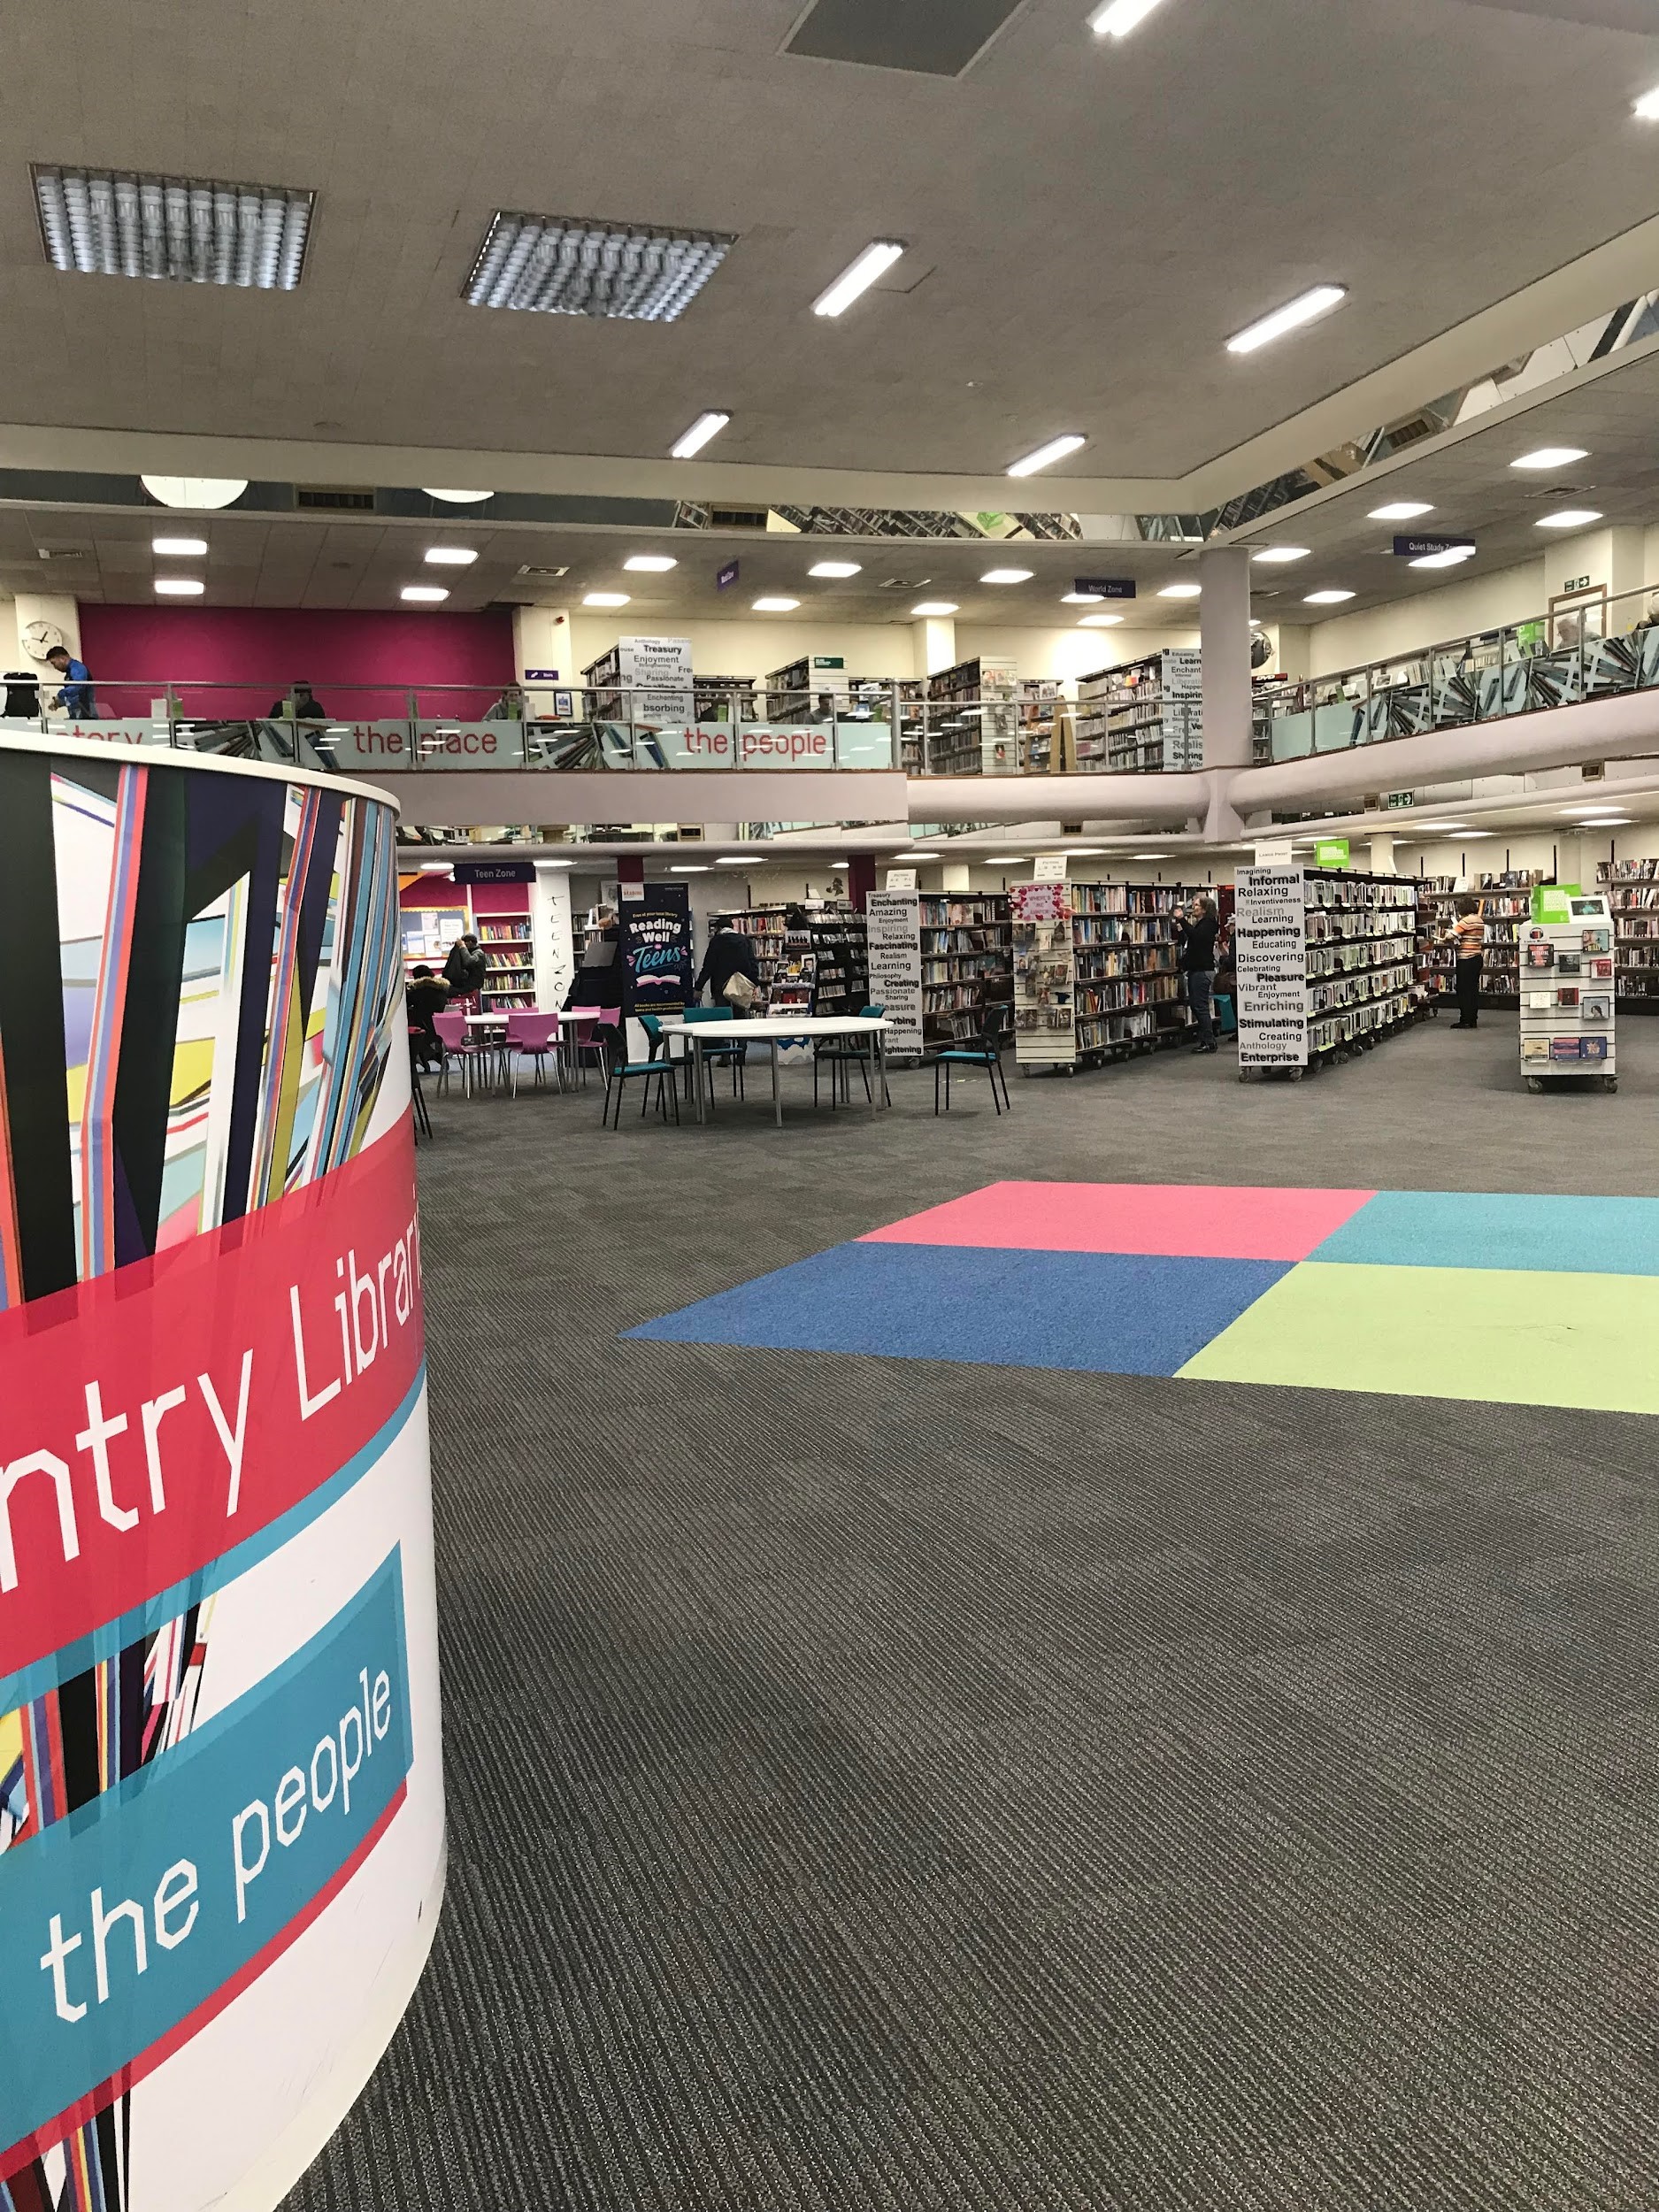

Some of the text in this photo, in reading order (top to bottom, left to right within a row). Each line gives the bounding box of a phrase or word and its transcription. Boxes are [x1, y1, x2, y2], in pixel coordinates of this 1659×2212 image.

[1409, 541, 1425, 551] Quiet
[1426, 542, 1444, 552] Study
[1108, 585, 1123, 594] Zone
[644, 644, 682, 655] Treasury
[634, 655, 679, 664] Enjoyment
[647, 694, 684, 703] Enchanting
[1172, 691, 1202, 700] Inspirin
[643, 703, 685, 714] bsorbing
[353, 726, 497, 762] the place
[684, 727, 826, 762] the people
[1172, 752, 1203, 761] Shring
[474, 868, 516, 879] Teen Zone
[1248, 873, 1300, 886] Informal
[1238, 886, 1288, 897] Relaxing
[871, 898, 918, 907] Enchanting
[869, 908, 908, 917] Amazing
[1236, 906, 1284, 917] Realism
[1252, 914, 1294, 924] Learning
[629, 918, 681, 934] Reading
[868, 925, 908, 934] Inspiring
[642, 932, 670, 943] Well
[1237, 926, 1301, 939] Happening
[869, 941, 918, 950] Fascinating
[1252, 940, 1297, 949] Educating
[633, 946, 680, 972] Teens
[1238, 952, 1304, 963] Discovering
[871, 962, 911, 972] Learning
[1256, 973, 1305, 982] Pleasure
[884, 979, 919, 988] Creating
[1238, 983, 1277, 992] Vibrant
[1244, 1001, 1304, 1013] Enriching
[1239, 1018, 1304, 1030] Stimulating
[1259, 1032, 1302, 1042] Creating
[885, 1046, 922, 1055] ightening
[1240, 1041, 1287, 1051] Anthology
[1240, 1052, 1300, 1064] Enterprise
[0, 1183, 422, 1594] ntry Librari
[41, 1667, 391, 2024] the people
